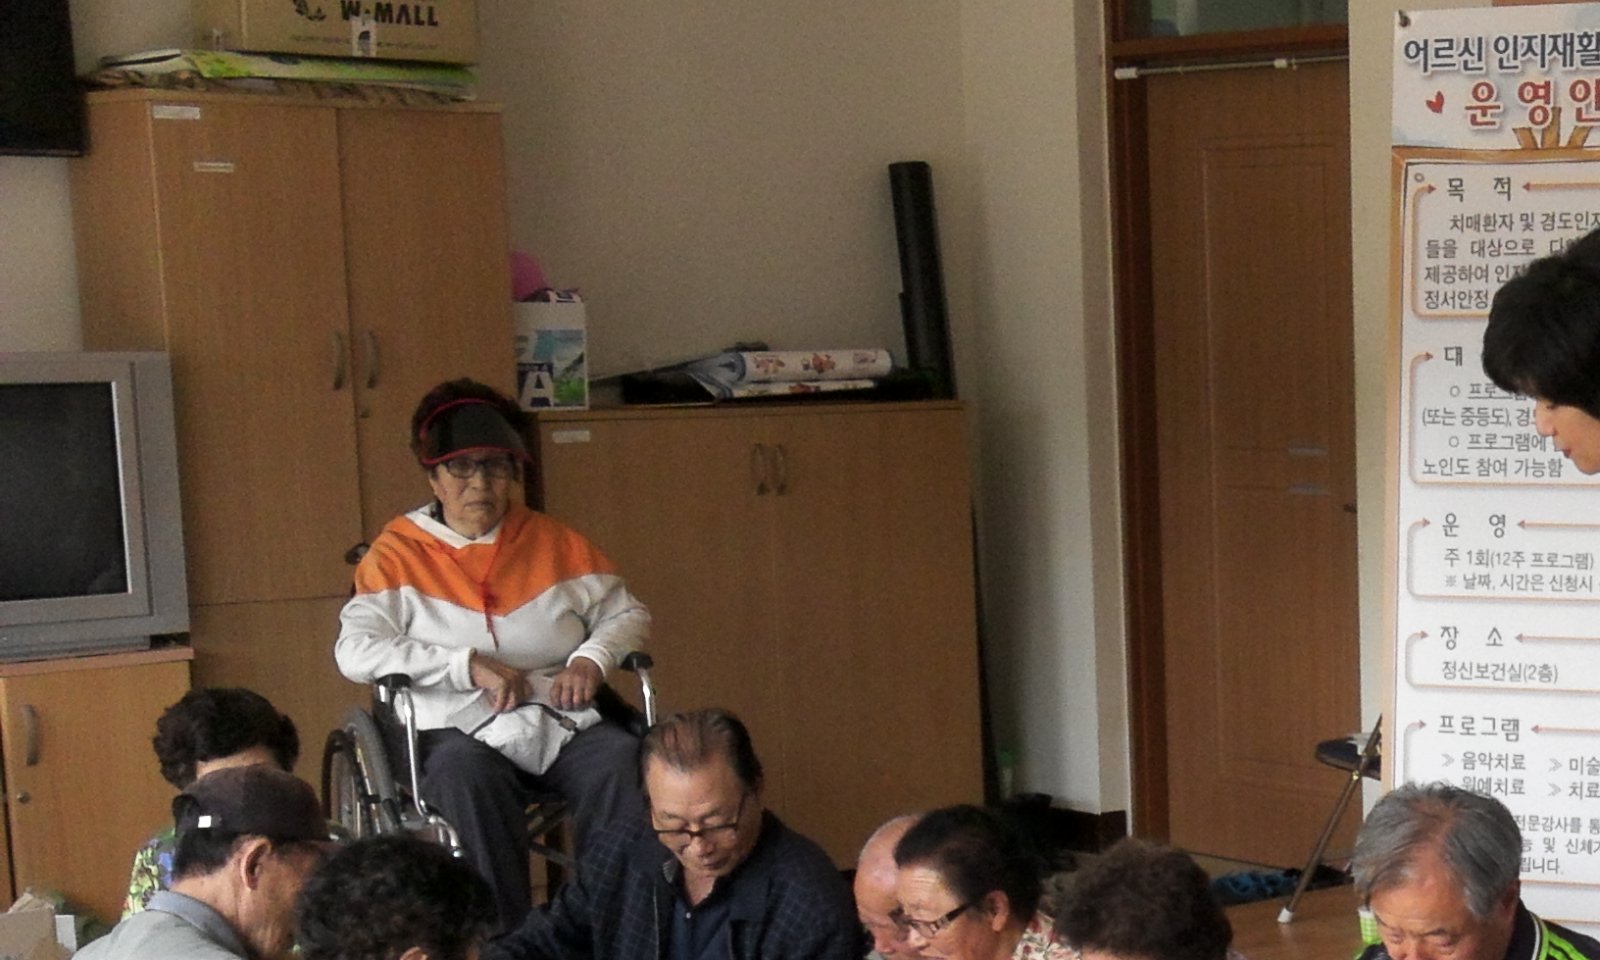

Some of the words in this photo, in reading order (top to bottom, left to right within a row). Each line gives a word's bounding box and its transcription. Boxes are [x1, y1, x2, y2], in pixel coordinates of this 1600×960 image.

[1404, 37, 1484, 73] 어르신
[1449, 213, 1514, 233] 치매환자
[1520, 212, 1535, 232] 및
[1425, 239, 1458, 259] 들을
[1470, 238, 1536, 258] 대상으로
[1425, 264, 1489, 284] 제공하여
[1425, 290, 1489, 309] 정서안정
[1444, 346, 1463, 367] 대
[1422, 407, 1456, 427] (또는
[1467, 433, 1546, 452] 프로그램에
[1422, 457, 1470, 477] 노인도
[1476, 457, 1508, 477] 참여
[1514, 458, 1563, 478] 가능함
[1444, 548, 1461, 568] 주
[1530, 552, 1594, 571] 프로그램)
[1500, 573, 1544, 592] 시간은
[1549, 574, 1592, 593] 신청시
[1442, 661, 1559, 684] 정신보건실(2층)
[1438, 715, 1520, 742] 프로그램
[1461, 751, 1526, 772] 음악치료
[1543, 837, 1556, 853] 및
